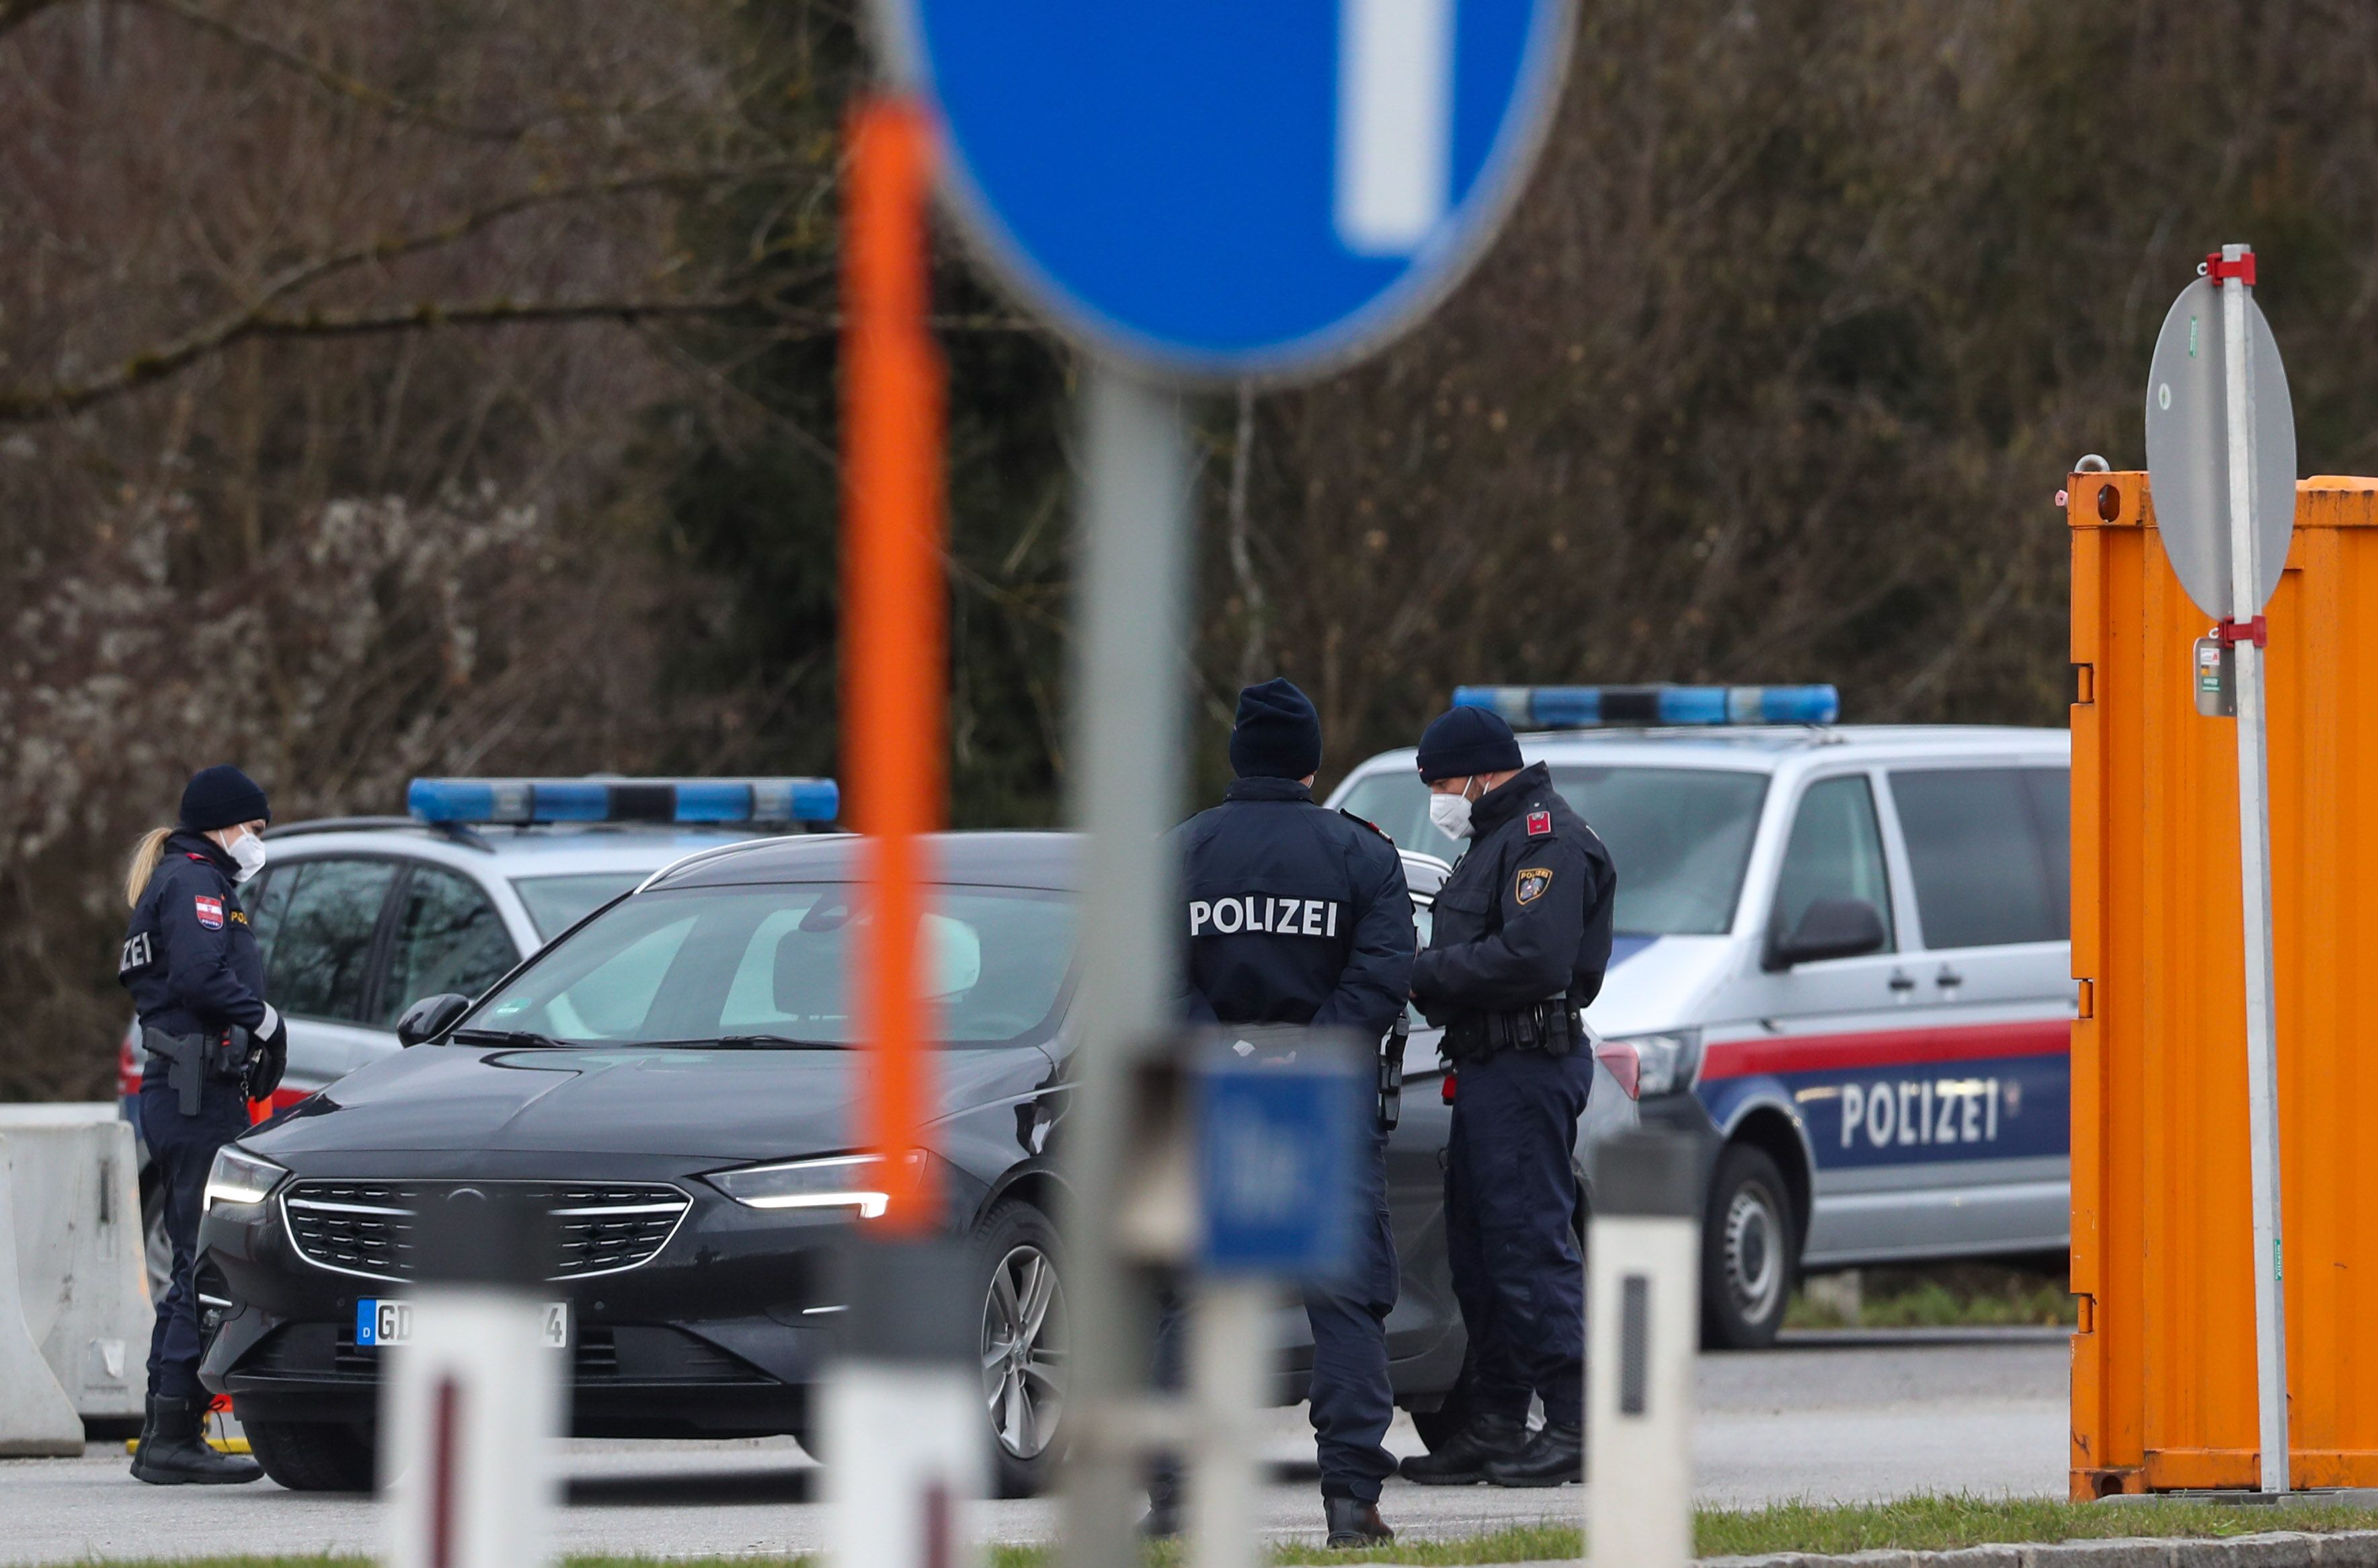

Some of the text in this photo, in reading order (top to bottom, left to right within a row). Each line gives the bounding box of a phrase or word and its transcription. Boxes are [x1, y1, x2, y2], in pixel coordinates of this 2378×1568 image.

[1521, 870, 1548, 879] POLIZEI
[1189, 896, 1338, 937] POLIZEI
[120, 932, 152, 972] ZEI
[1841, 1078, 1999, 1148] POLIZEI
[363, 1327, 370, 1338] D
[379, 1306, 413, 1340] GD
